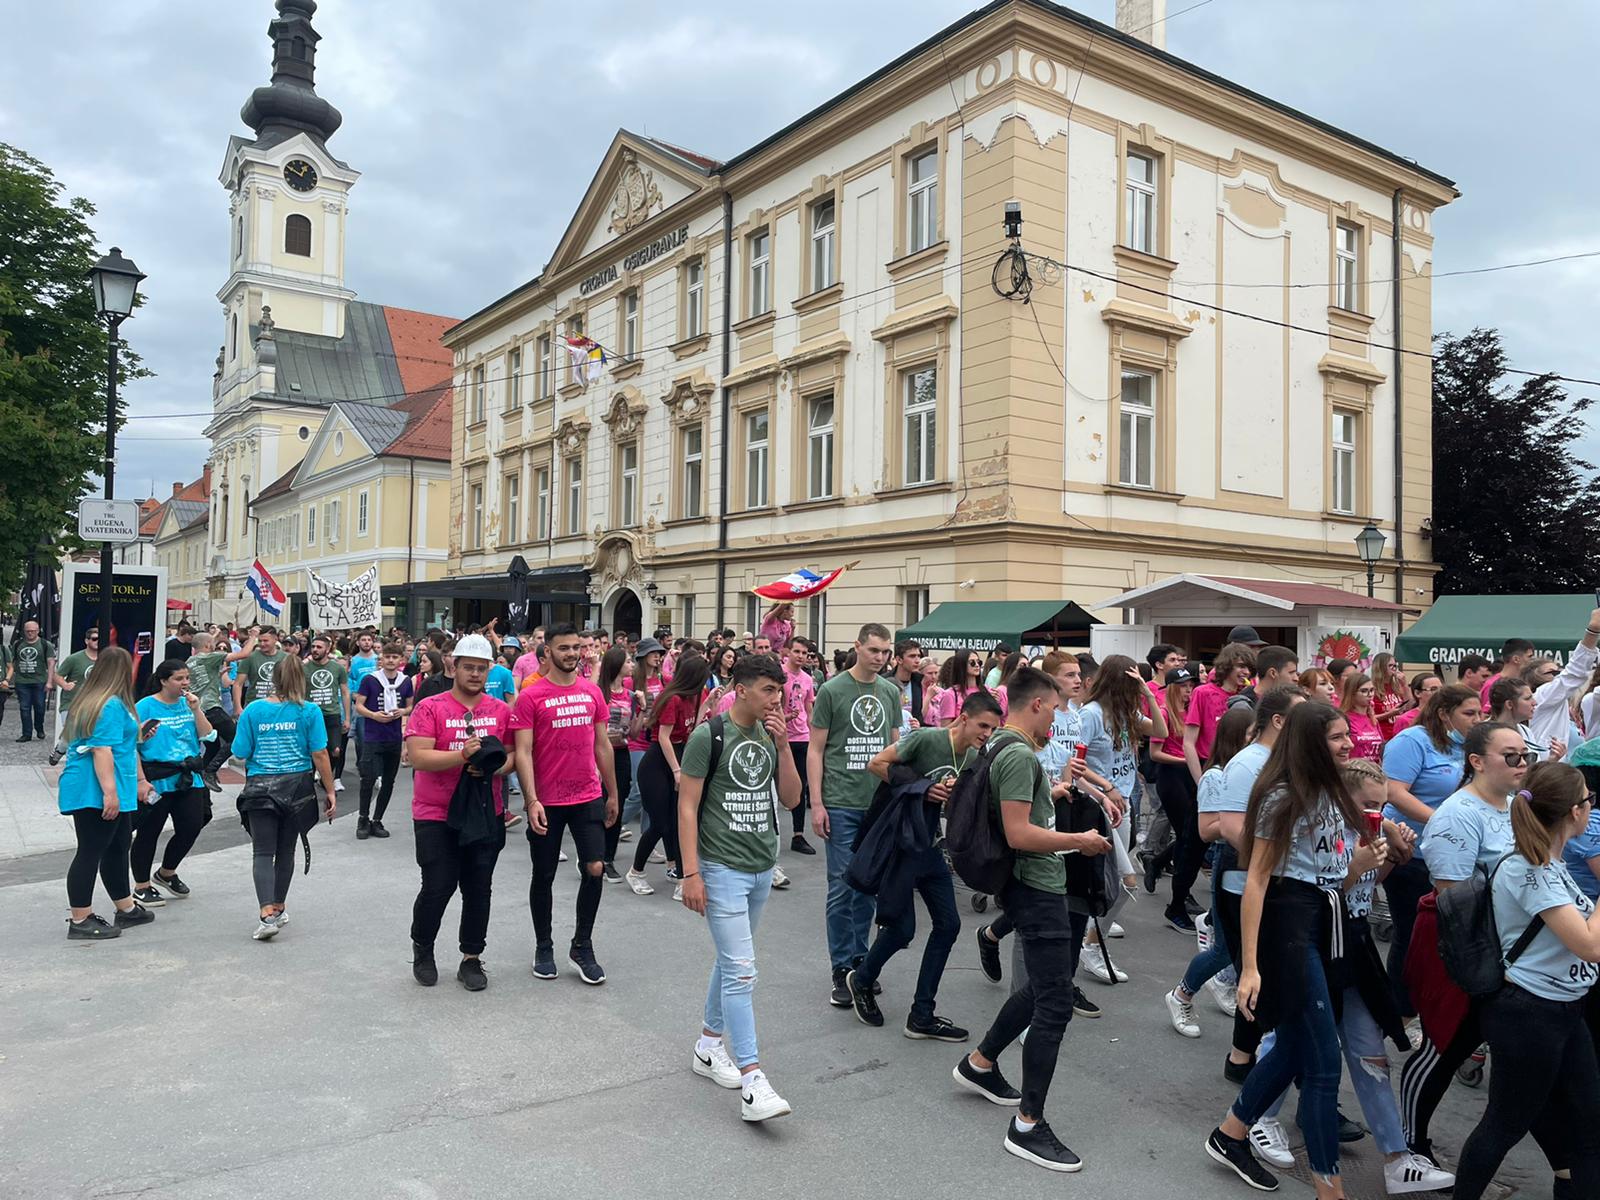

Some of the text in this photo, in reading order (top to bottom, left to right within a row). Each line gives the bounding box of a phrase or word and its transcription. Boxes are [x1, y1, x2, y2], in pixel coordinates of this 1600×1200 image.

[580, 223, 690, 296] CROATIA OSIGURANJE
[94, 519, 125, 527] EUGENA
[84, 526, 134, 535] KVATERNIKA
[940, 636, 966, 650] TRŽNICA
[545, 695, 567, 708] BOLJE
[557, 704, 588, 717] ALKOHOL
[275, 721, 296, 731] SVEKI
[552, 717, 572, 729] NEGO
[847, 736, 867, 745] DOSTA
[844, 745, 866, 753] STRUJE
[850, 753, 869, 761] DAJTE
[725, 791, 751, 801] DOSTA
[721, 801, 751, 812] STRUJE
[731, 812, 755, 822] DAJTE
